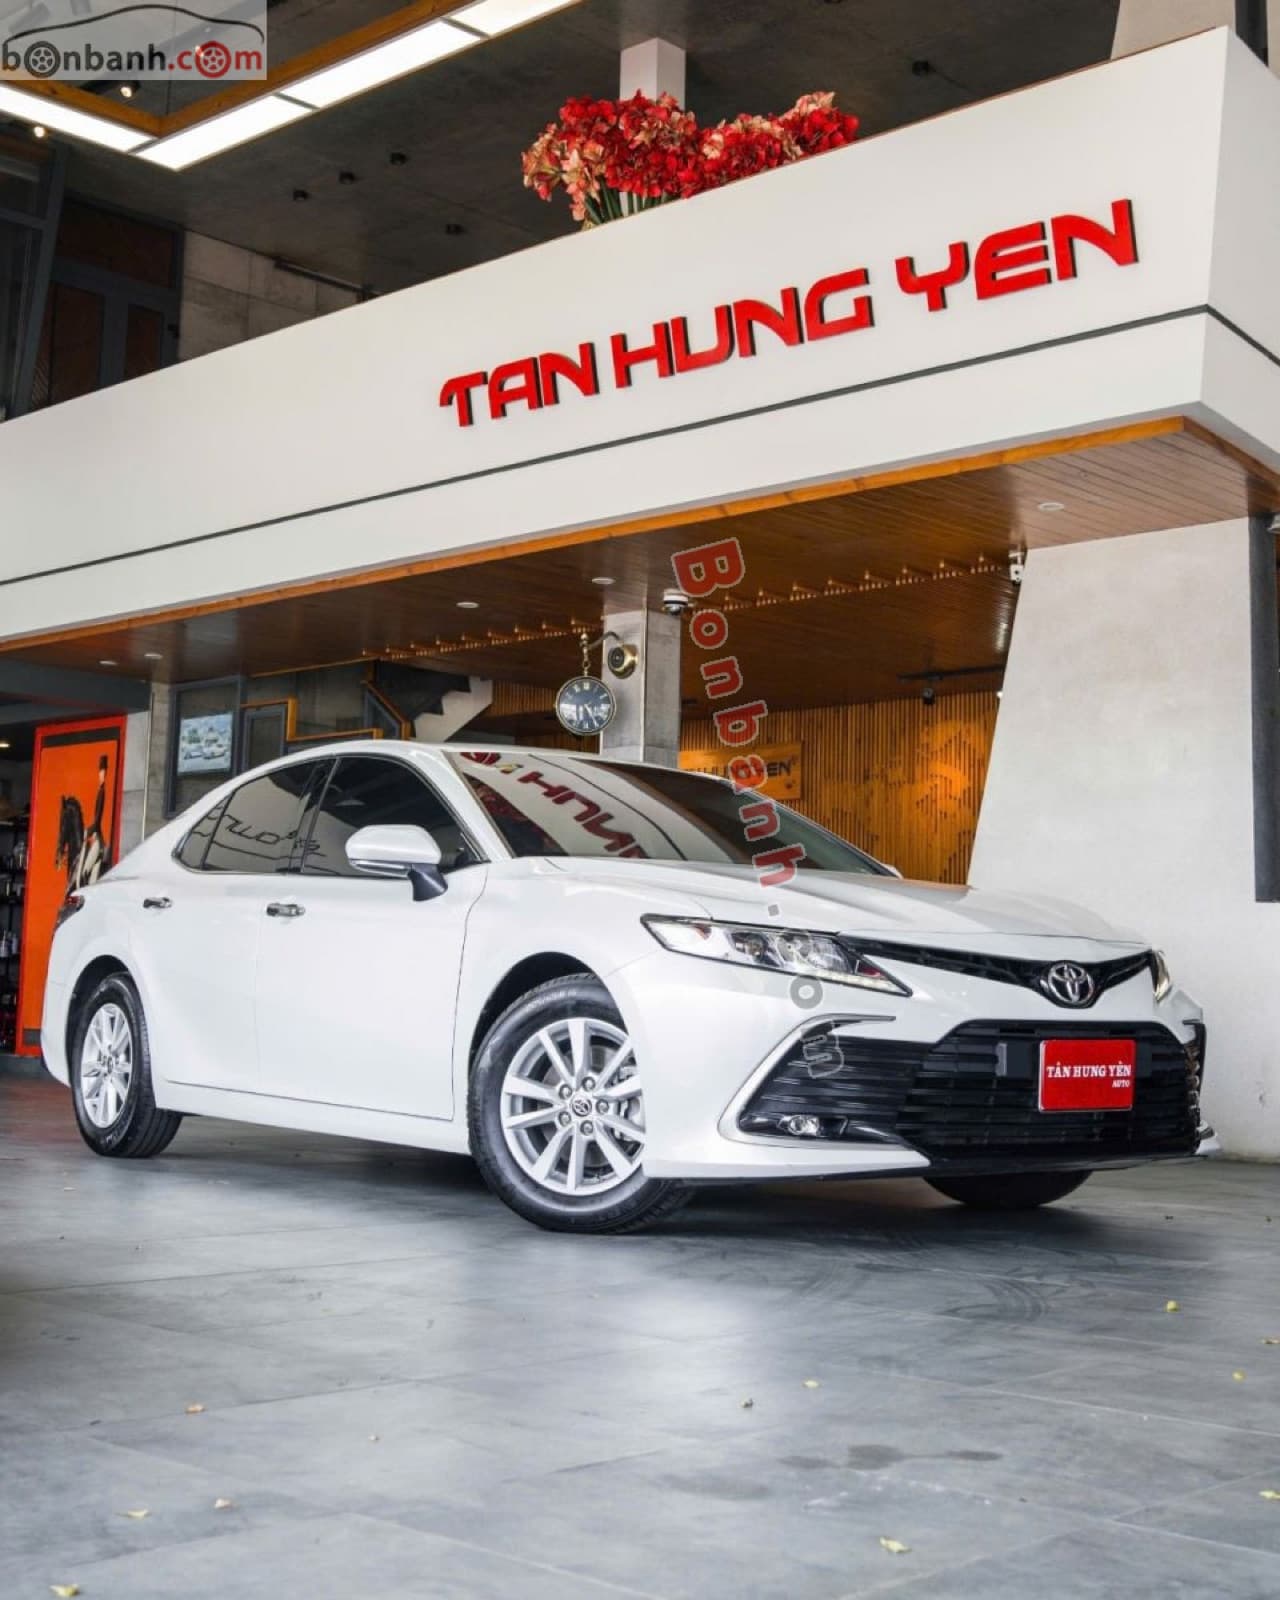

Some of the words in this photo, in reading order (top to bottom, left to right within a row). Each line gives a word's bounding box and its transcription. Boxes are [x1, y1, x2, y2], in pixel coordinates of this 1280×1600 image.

[439, 342, 600, 427] TAN
[610, 267, 875, 389] HUNG
[895, 198, 1139, 312] YEN
[1112, 1080, 1130, 1088] AUTO
